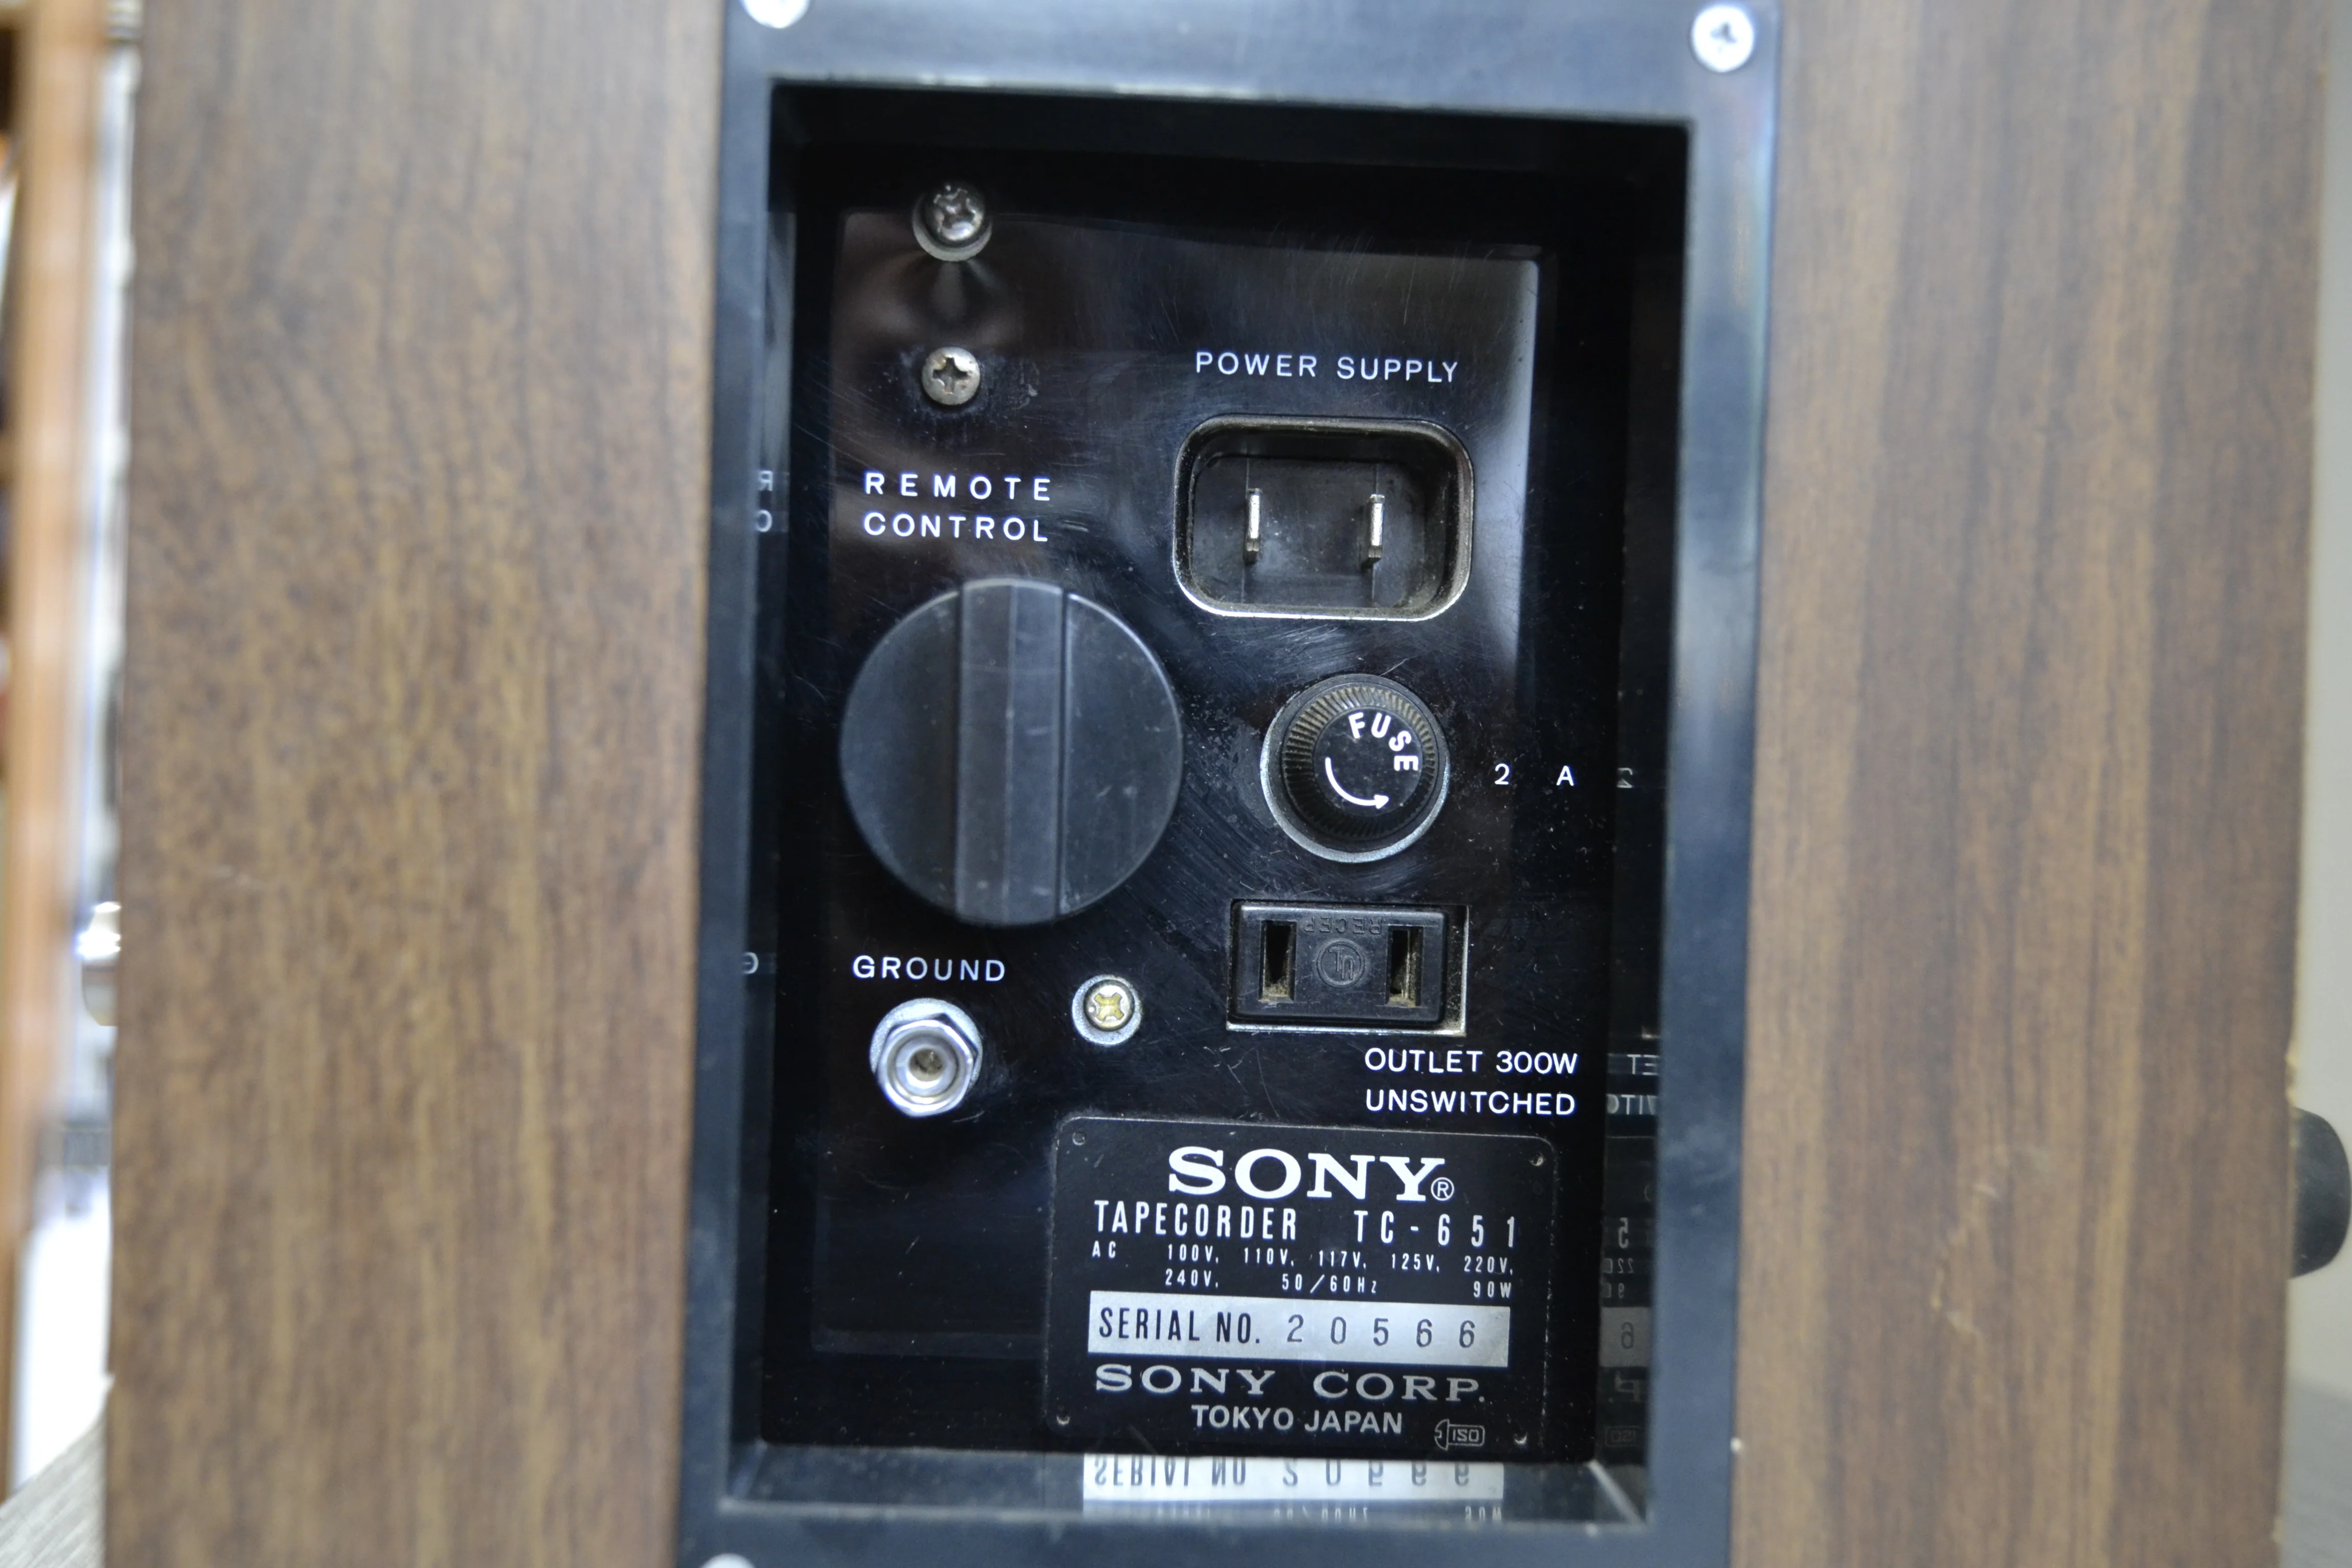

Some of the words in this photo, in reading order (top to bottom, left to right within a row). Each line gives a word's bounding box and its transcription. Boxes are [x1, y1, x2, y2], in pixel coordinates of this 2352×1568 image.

[1195, 351, 1318, 378] POWER
[1336, 355, 1458, 383] SUPPLY
[864, 471, 1051, 502] REMOTE
[863, 511, 1049, 543] CONTROL
[1348, 711, 1419, 772] FUSE
[1493, 762, 1511, 786] 2
[1555, 764, 1575, 788] A
[852, 954, 1006, 982] GROUND
[1364, 1046, 1484, 1074] OUTLET
[1495, 1049, 1579, 1075] 300W
[1365, 1088, 1576, 1116] UNSWITCHED
[1093, 1199, 1297, 1241] TAPECORDER
[1091, 1241, 1117, 1260] AC
[1473, 1280, 1512, 1299] 90W
[1098, 1307, 1201, 1342] SERIAL
[1215, 1310, 1261, 1345] NO.
[1285, 1313, 1476, 1350] 20566
[1095, 1363, 1276, 1395] SONY
[1312, 1370, 1485, 1403] CORP.
[1190, 1404, 1294, 1431] TOKYO
[1303, 1409, 1403, 1435] JAPAN
[1452, 1428, 1480, 1442] ISO
